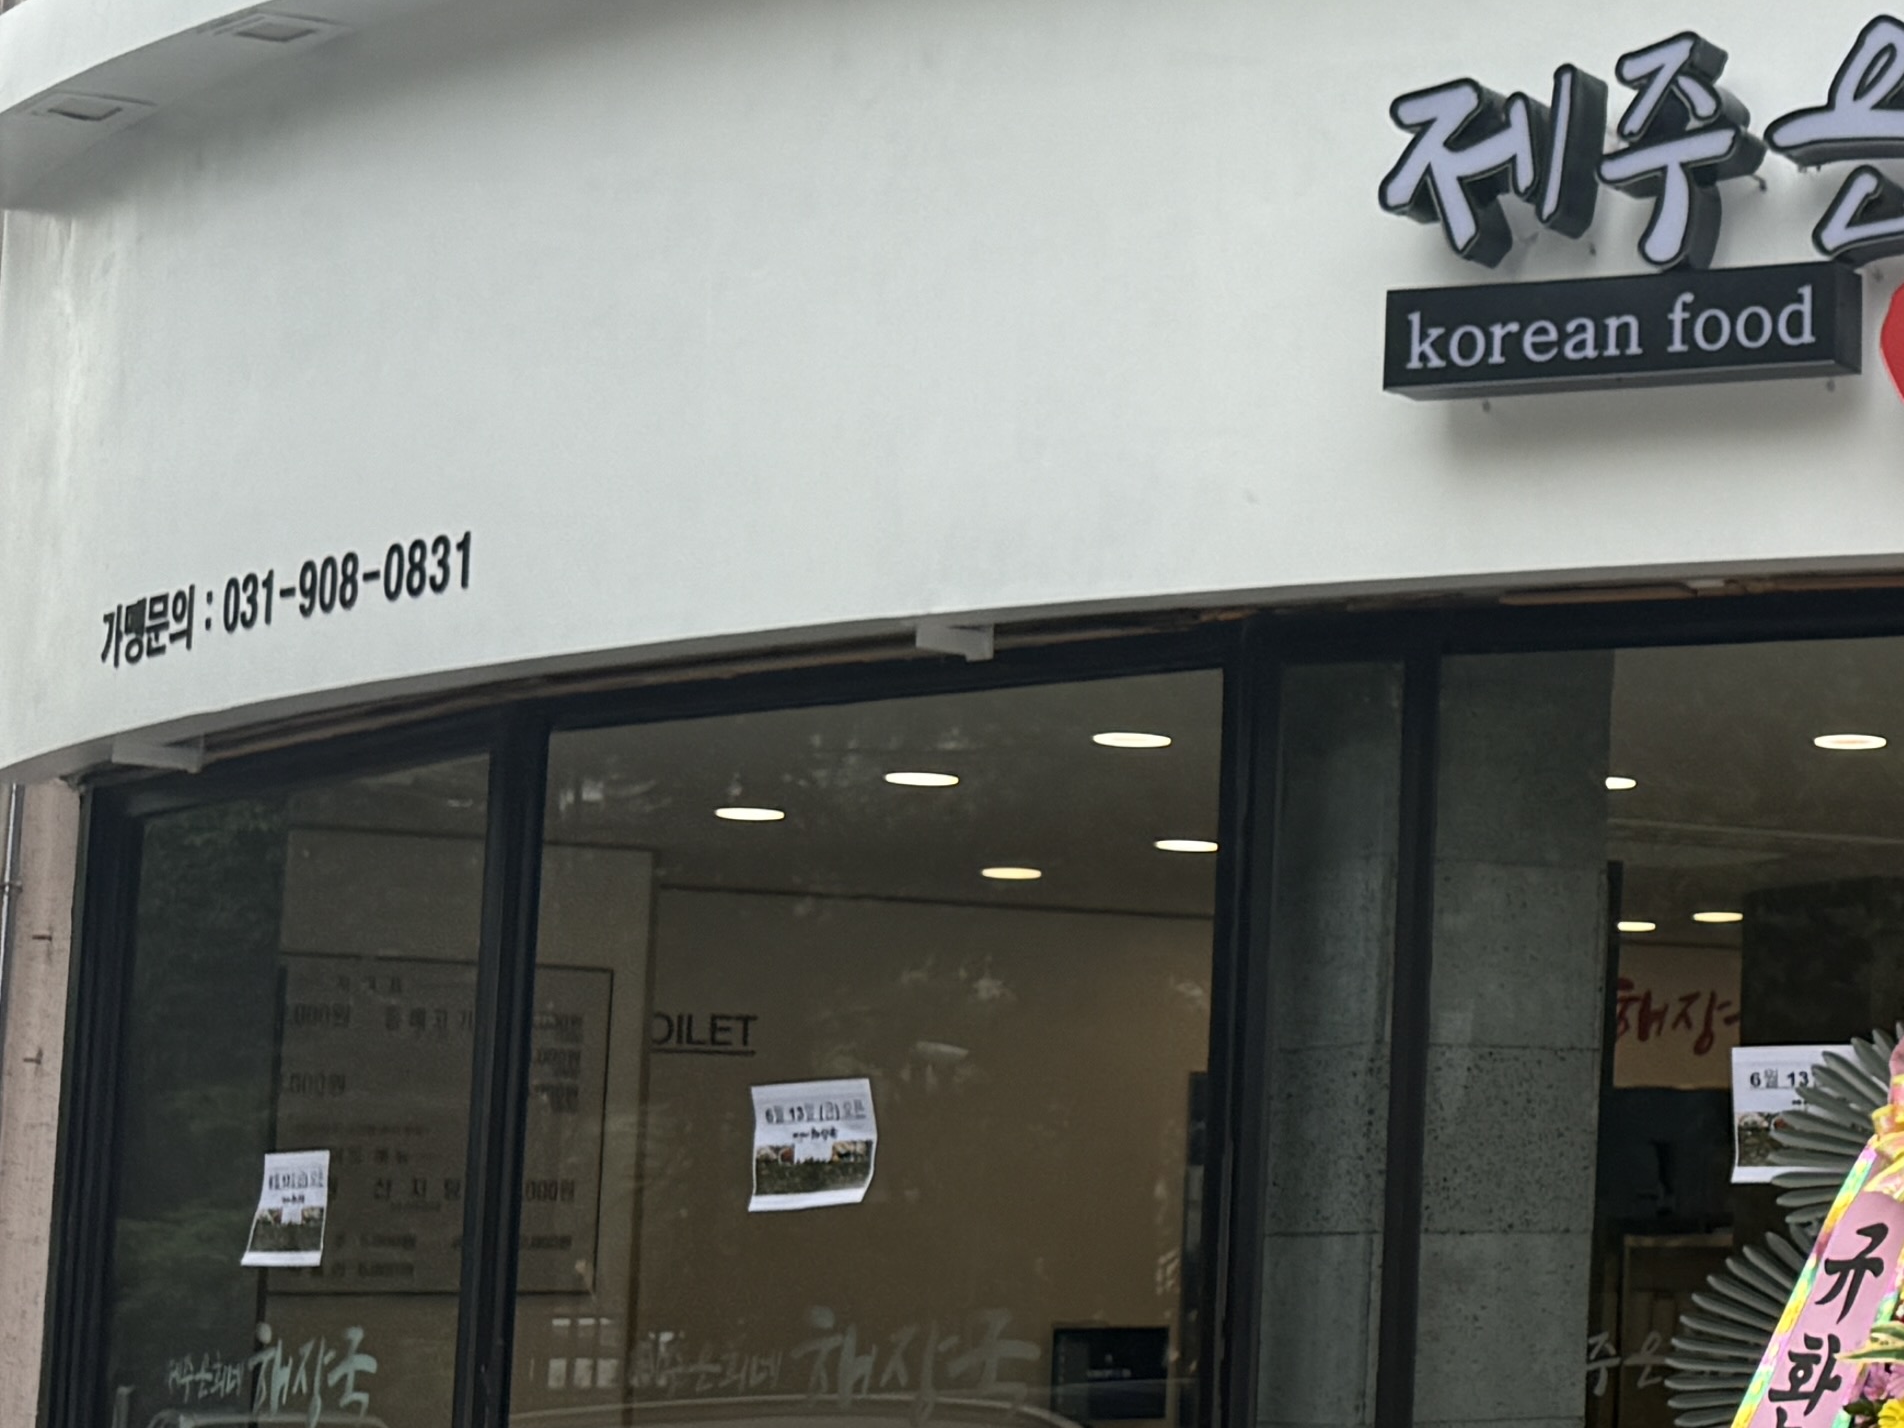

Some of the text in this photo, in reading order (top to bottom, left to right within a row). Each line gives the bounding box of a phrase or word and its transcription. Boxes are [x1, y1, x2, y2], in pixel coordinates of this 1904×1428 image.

[1405, 289, 1817, 369] korean food
[101, 583, 195, 668] 가맹문의
[222, 530, 472, 633] 031-908-0831
[1617, 977, 1740, 1055] 해장
[1749, 1067, 1780, 1089] 6월
[791, 1305, 1042, 1428] 해장국
